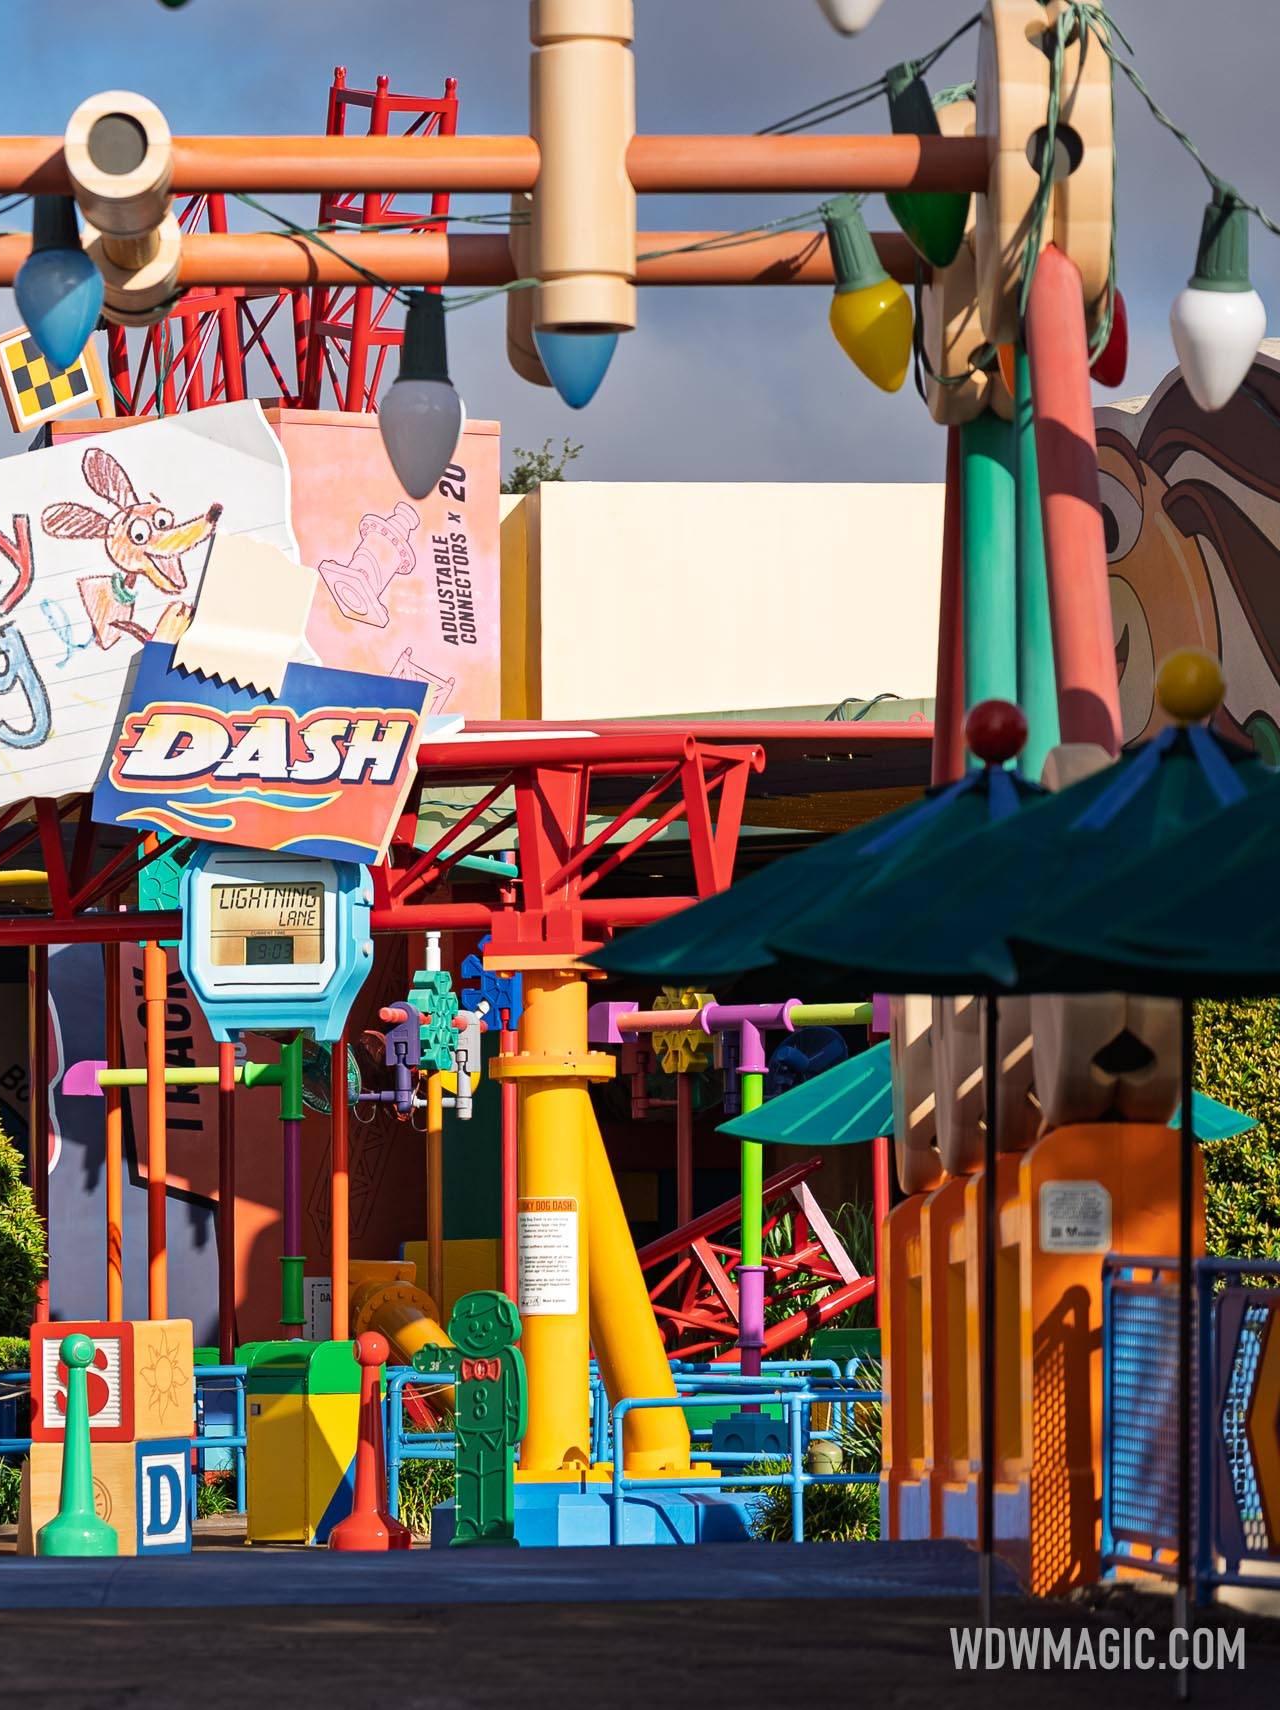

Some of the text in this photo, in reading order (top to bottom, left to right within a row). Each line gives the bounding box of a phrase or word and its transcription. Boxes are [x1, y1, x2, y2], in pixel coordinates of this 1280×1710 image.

[438, 463, 467, 503] 20
[432, 534, 460, 646] ADJUSTABLE
[450, 533, 477, 645] CONNECTORS
[120, 713, 414, 785] DASH
[219, 887, 317, 909] LIGHTNING
[279, 910, 316, 927] LANE
[146, 1464, 182, 1536] D
